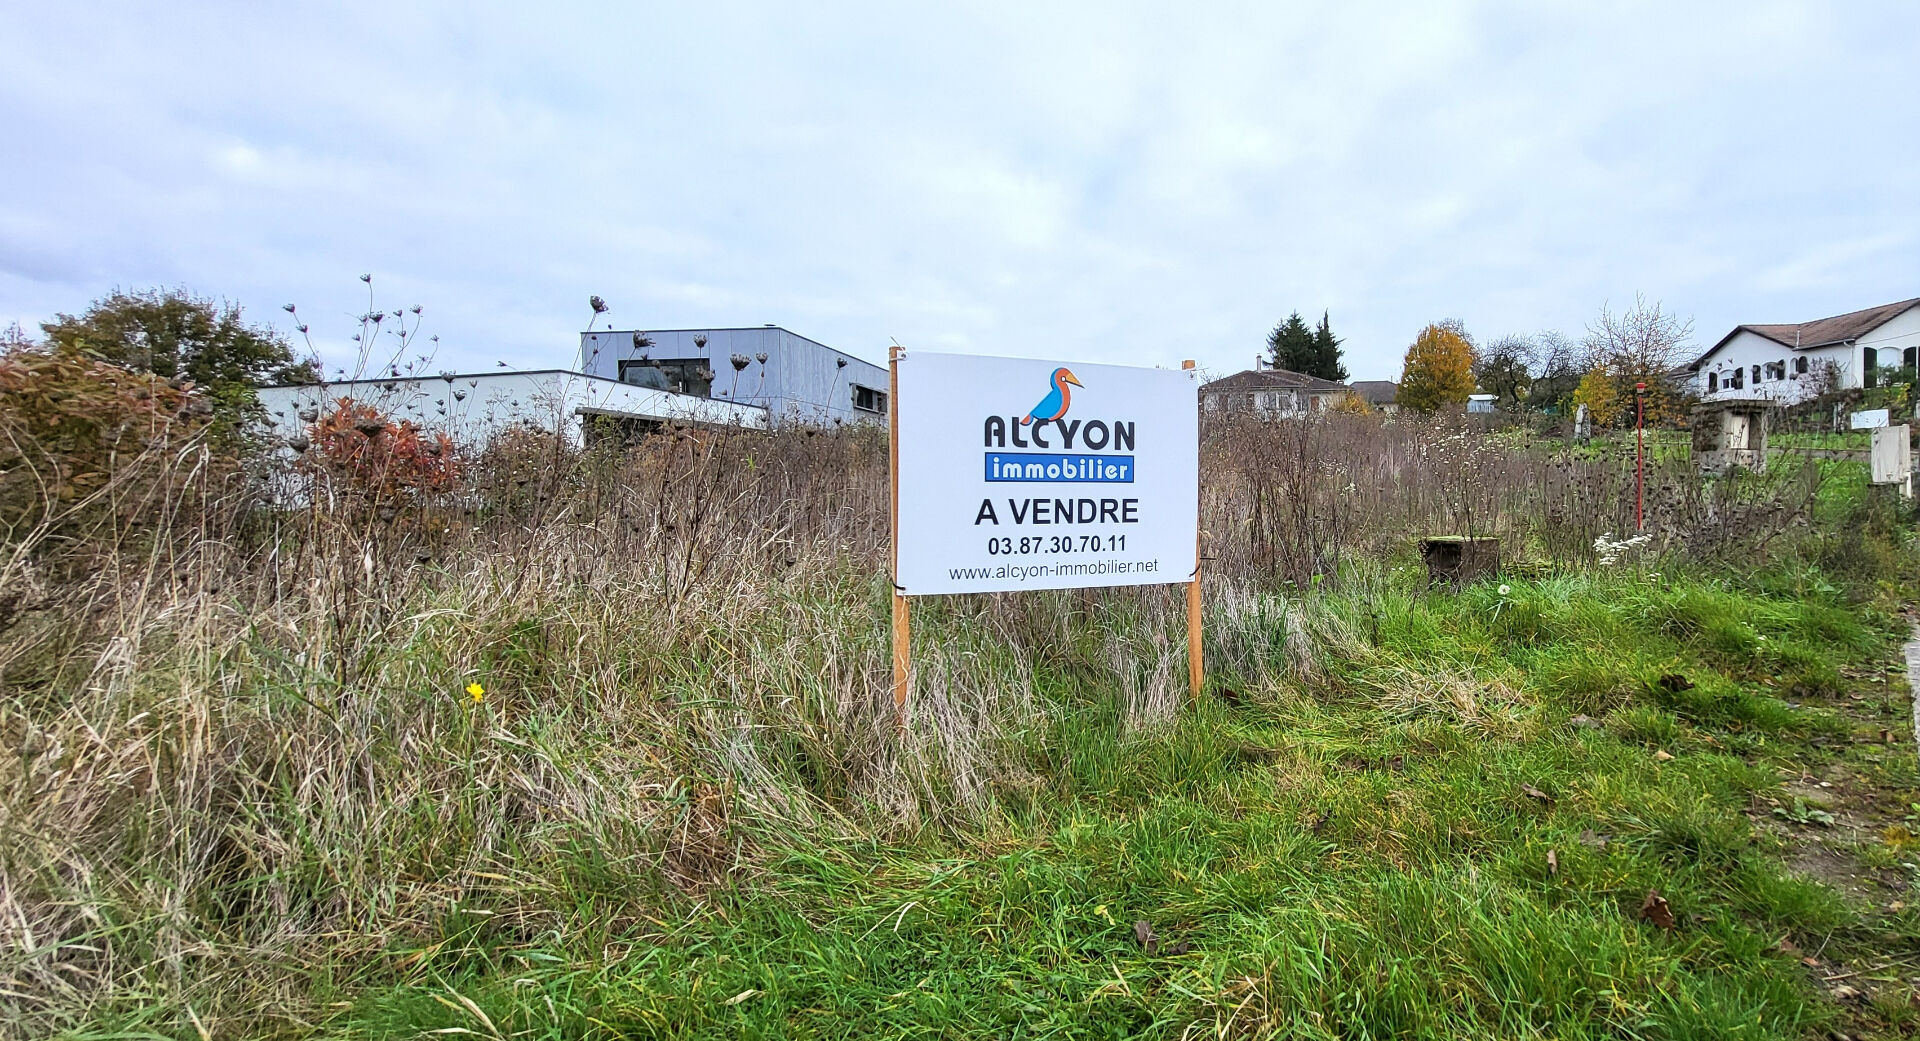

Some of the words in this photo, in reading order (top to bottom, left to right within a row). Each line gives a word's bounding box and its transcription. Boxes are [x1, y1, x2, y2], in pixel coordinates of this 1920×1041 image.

[984, 415, 1135, 451] ALCYON
[993, 456, 1128, 480] immobilier
[974, 498, 1000, 525] A
[1008, 498, 1139, 525] VENDRE
[987, 534, 1126, 555] 03.87.30.70.11
[949, 558, 1158, 580] www.alcyon-immobilier.net
